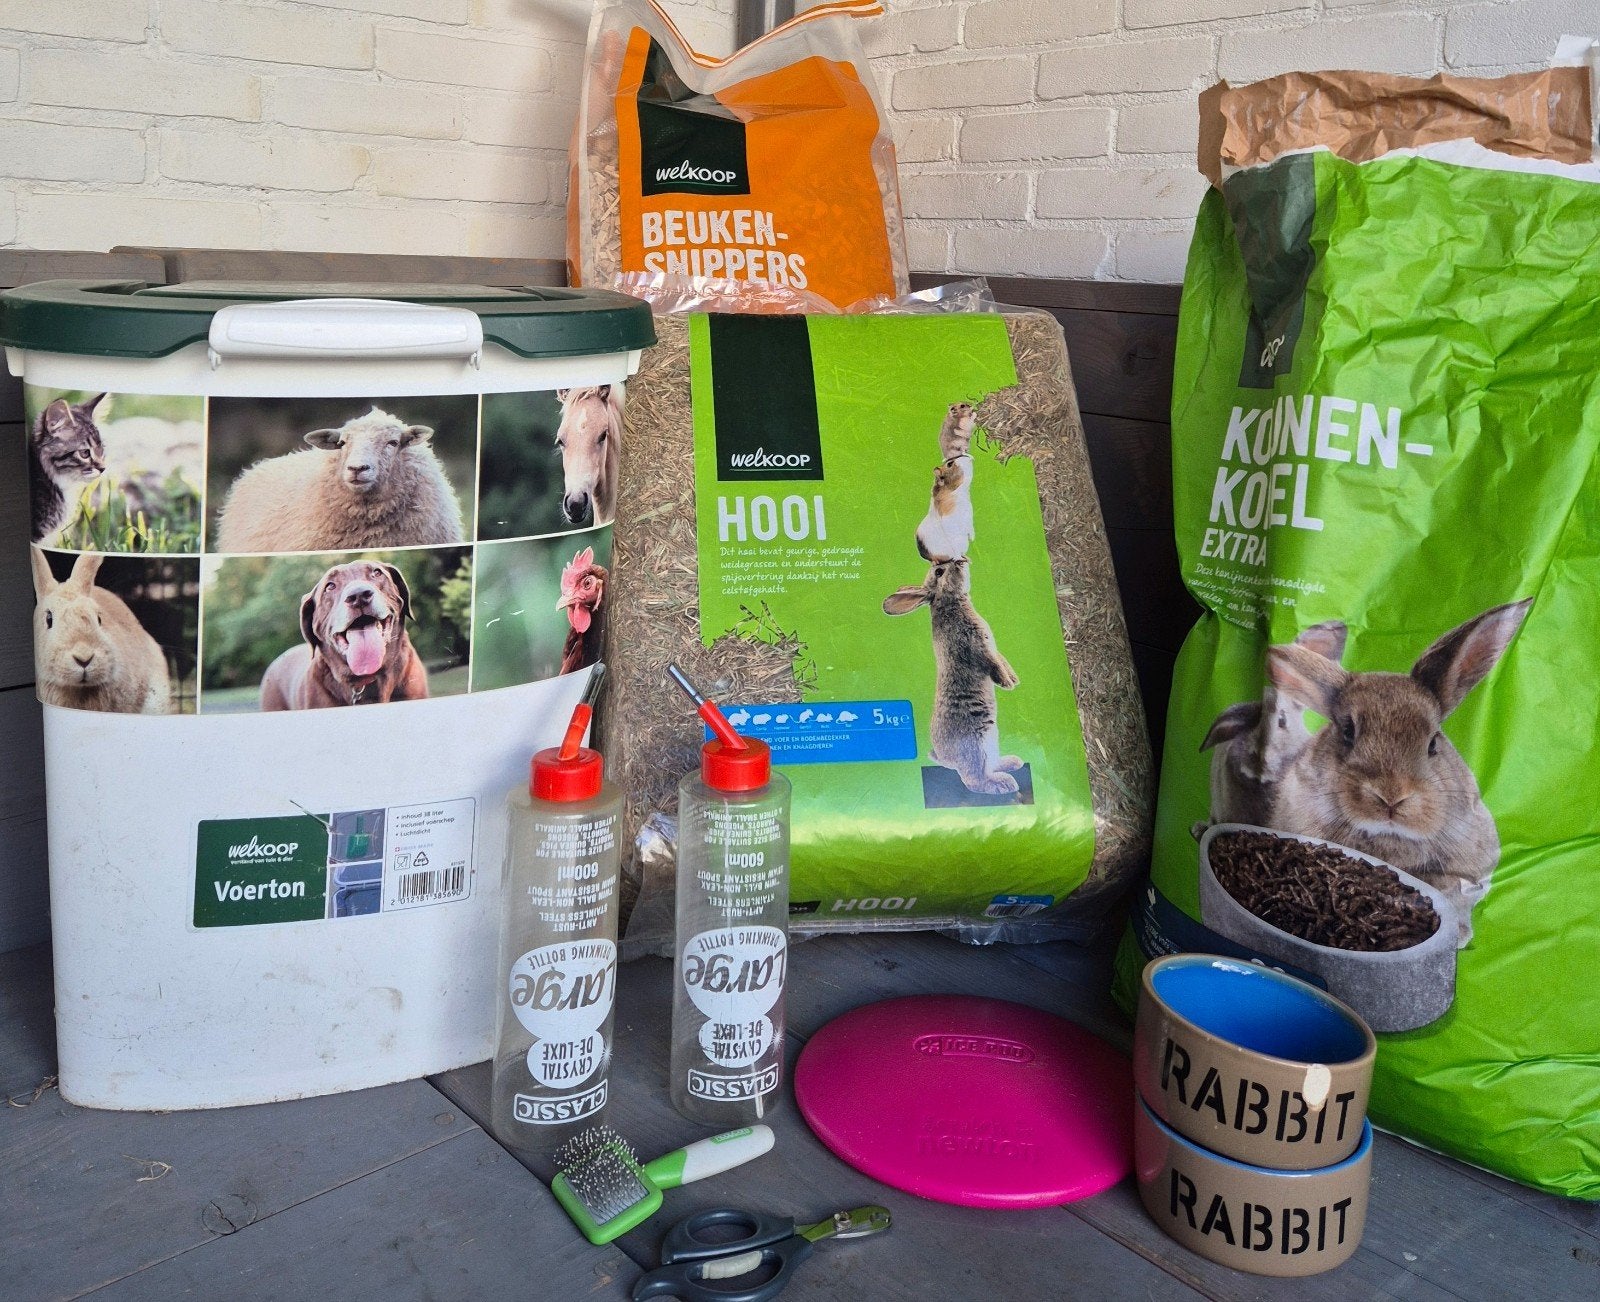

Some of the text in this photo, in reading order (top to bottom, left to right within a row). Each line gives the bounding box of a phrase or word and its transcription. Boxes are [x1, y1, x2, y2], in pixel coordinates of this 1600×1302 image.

[642, 210, 788, 248] BEUKEN-
[644, 248, 808, 289] SNIPPERS
[718, 495, 827, 541] HOOI
[720, 547, 735, 556] Dit
[759, 546, 783, 556] bevat
[786, 546, 820, 558] geurige,
[1200, 528, 1266, 567] EXTRA
[720, 560, 778, 571] weidegrassen
[782, 560, 791, 568] en
[851, 558, 862, 567] de
[722, 573, 784, 584] spijsvertering
[822, 572, 837, 580] het
[840, 572, 860, 580] ruwe
[703, 810, 732, 820] ANIMALS
[735, 811, 758, 821] SMALL
[759, 808, 778, 820] OTHER
[535, 824, 567, 834] ANIMALS
[569, 822, 592, 833] SMALL
[594, 817, 612, 830] OTHER
[714, 821, 744, 830] PIGEONS
[548, 833, 578, 841] PIGEONS
[704, 831, 781, 846] THIS SIZE SUITABLE FOR
[726, 830, 751, 838] GUINEA
[560, 840, 586, 849] GUINEA
[588, 845, 602, 855] SIZE
[536, 848, 549, 858] FOR
[551, 848, 586, 858] SUITABLE
[725, 852, 764, 868] 600ml
[558, 862, 598, 882] 600ml
[696, 869, 720, 882] SPOUT
[723, 872, 766, 883] RESISTANT
[214, 878, 305, 902] Voerton
[527, 886, 552, 897] SPOUT
[556, 883, 600, 897] RESISTANT
[701, 878, 780, 893] TWIN BALL NON-LEAK
[400, 895, 429, 904] 012181
[433, 889, 462, 900] 385690
[532, 897, 574, 907] NON-LEAK
[577, 893, 596, 905] BALL
[708, 892, 775, 906] STAINLESS STEEL
[721, 905, 764, 917] ANTI-RUST
[831, 897, 917, 911] HOOI
[539, 903, 608, 922] STAINLESS STEEL
[553, 918, 597, 931] ANTI-RUST
[698, 932, 780, 952] DRINKING BOTTLE
[527, 944, 611, 971] DRINKING BOTTLE
[685, 948, 785, 993] Large
[513, 960, 615, 1011] Large
[714, 1020, 762, 1039] DE-LUXE
[542, 1036, 594, 1060] DE-LUXE
[712, 1039, 762, 1060] CRYSTAL
[542, 1056, 593, 1080] CRYSTAL
[691, 1071, 776, 1097] CLASSIC
[1161, 1038, 1355, 1144] RABBIT
[518, 1088, 605, 1120] CLASSIC
[1171, 1168, 1352, 1255] RABBIT
